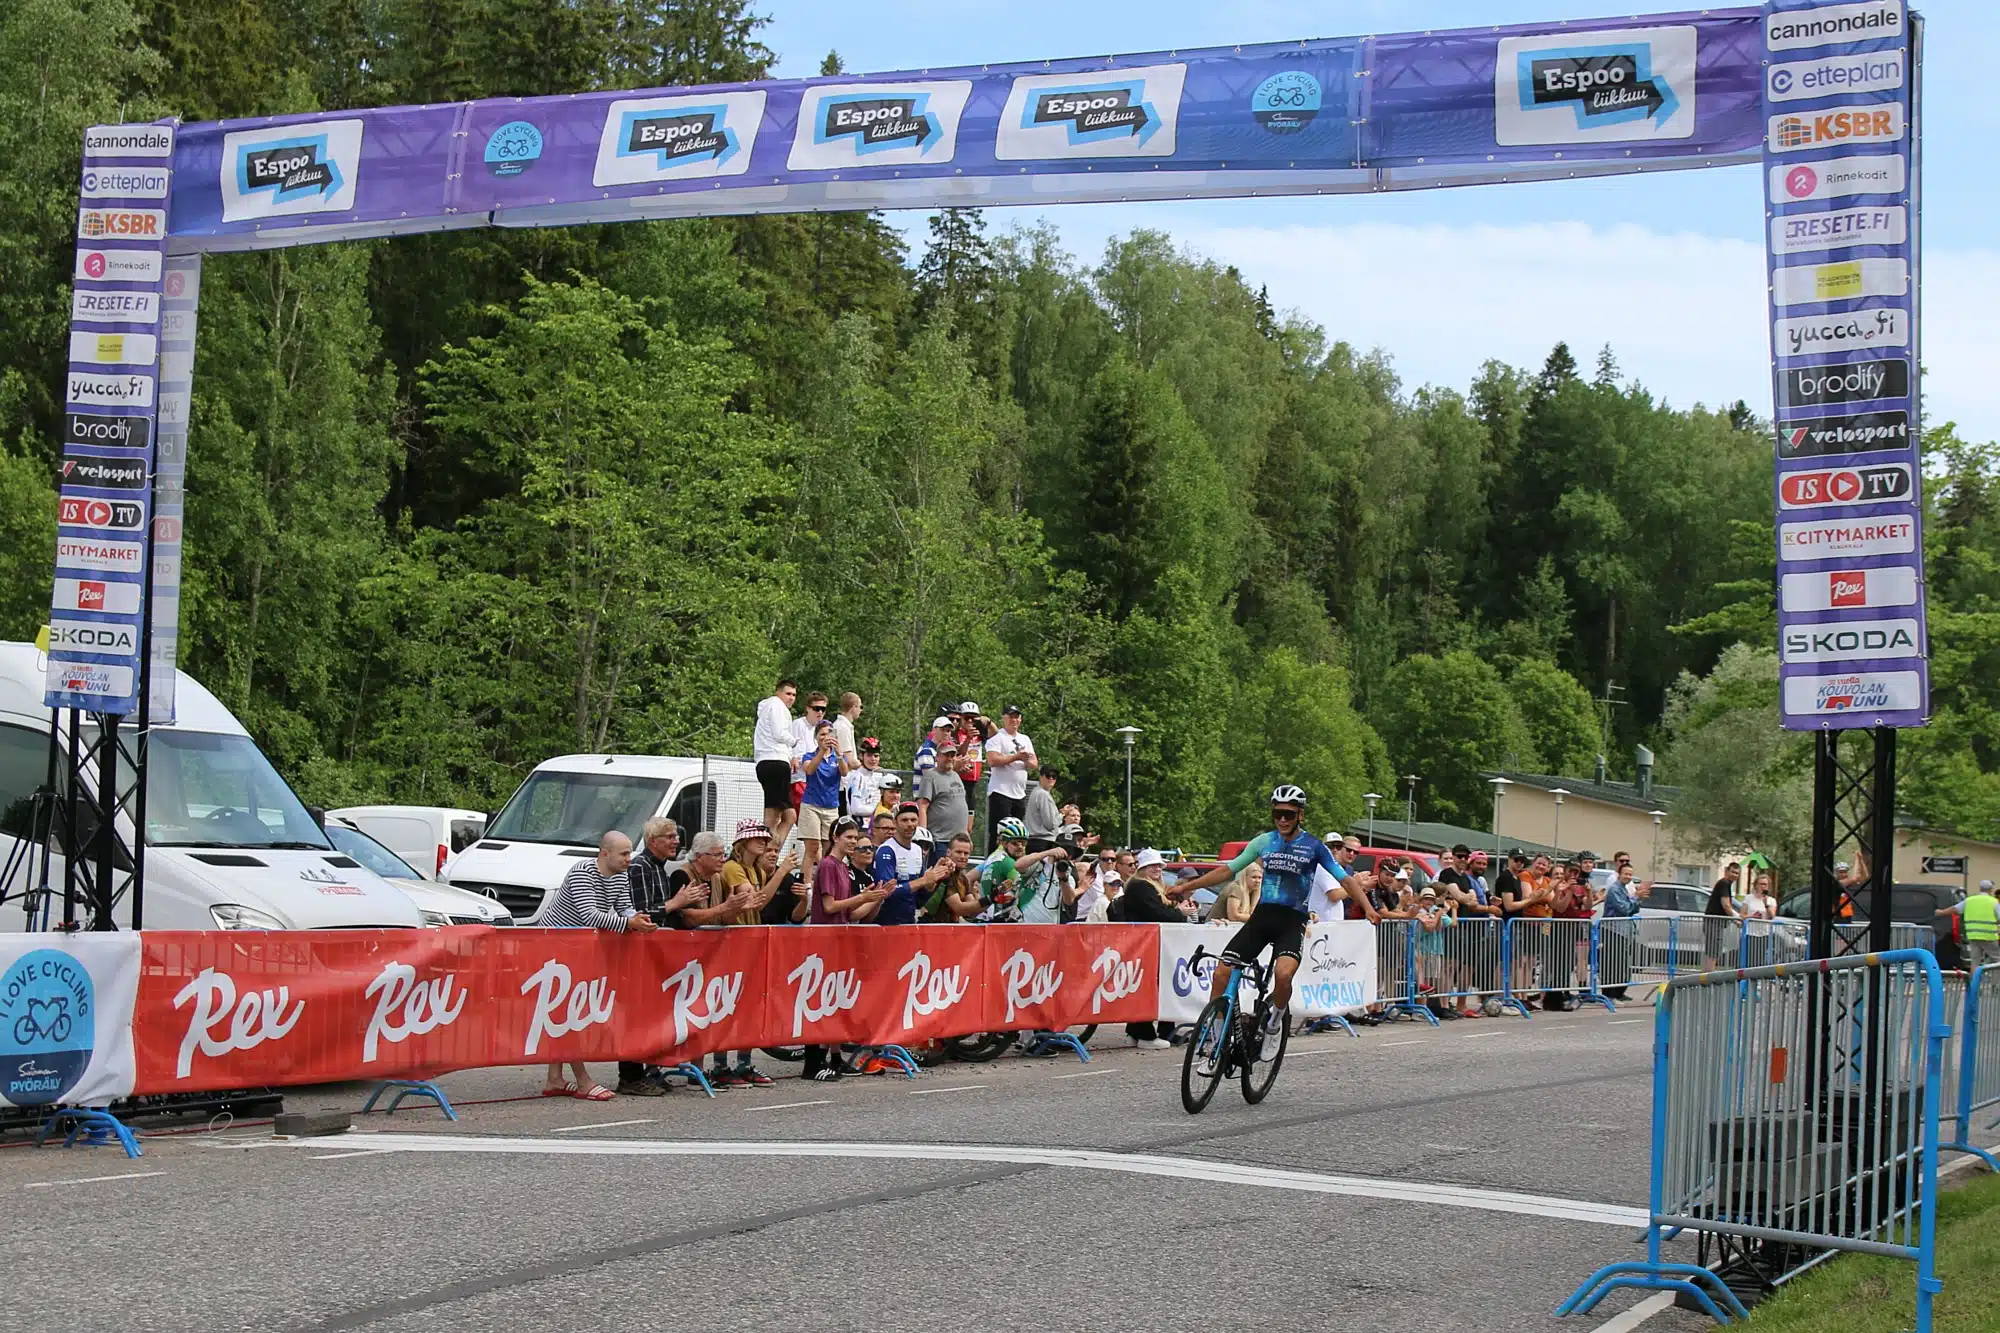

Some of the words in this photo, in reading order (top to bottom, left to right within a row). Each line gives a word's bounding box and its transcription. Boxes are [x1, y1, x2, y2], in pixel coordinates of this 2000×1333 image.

[1770, 10, 1898, 40] cannondale
[1262, 77, 1283, 92] LOVE
[1287, 74, 1316, 96] CYCLING
[1544, 67, 1625, 92] Espoo
[1802, 61, 1899, 88] etteplan
[1047, 96, 1118, 117] Espoo
[1593, 88, 1649, 108] liikkuu
[836, 105, 903, 129] Espoo
[1084, 110, 1135, 127] liikkuu
[1814, 111, 1894, 142] KSBR
[495, 128, 512, 144] LOVE
[514, 126, 538, 148] CYCLING
[640, 121, 704, 144] Espoo
[872, 120, 920, 138] liikkuu
[86, 134, 169, 149] cannondale
[673, 137, 718, 154] liikkuu
[254, 155, 309, 178] Espoo
[1826, 170, 1888, 184] Rinnekodit
[102, 173, 165, 194] etteplan
[285, 169, 323, 188] liikkuu
[105, 213, 157, 235] KSBR
[1789, 310, 1895, 352] yucca.fi
[72, 377, 143, 400] yucca.fi
[1799, 365, 1885, 397] brodify
[73, 416, 131, 445] brodify
[1811, 422, 1906, 444] velosport
[77, 465, 142, 482] velosport
[1796, 478, 1818, 500] IS
[1868, 472, 1898, 494] TV
[62, 503, 78, 520] IS
[116, 507, 136, 524] TV
[1796, 524, 1910, 545] CITYMARKET
[60, 544, 138, 561] CITYMARKET
[80, 588, 104, 602] Rex
[1832, 581, 1864, 600] Rex
[62, 670, 110, 682] KOUVOLAN
[1817, 683, 1886, 697] KOUVOLAN
[1268, 864, 1301, 874] MONDIALE
[4, 963, 38, 1010] LOVE
[42, 960, 89, 1018] CYCLING
[898, 950, 970, 1030] Rex
[1000, 947, 1064, 1024] Rex
[1091, 946, 1144, 1015] Rex
[661, 958, 744, 1046] Rex
[787, 953, 861, 1038] Rex
[1300, 976, 1366, 1010] PYÖRÄILY
[362, 960, 468, 1063] Rex
[520, 958, 616, 1056] Rex
[173, 966, 306, 1080] Rex
